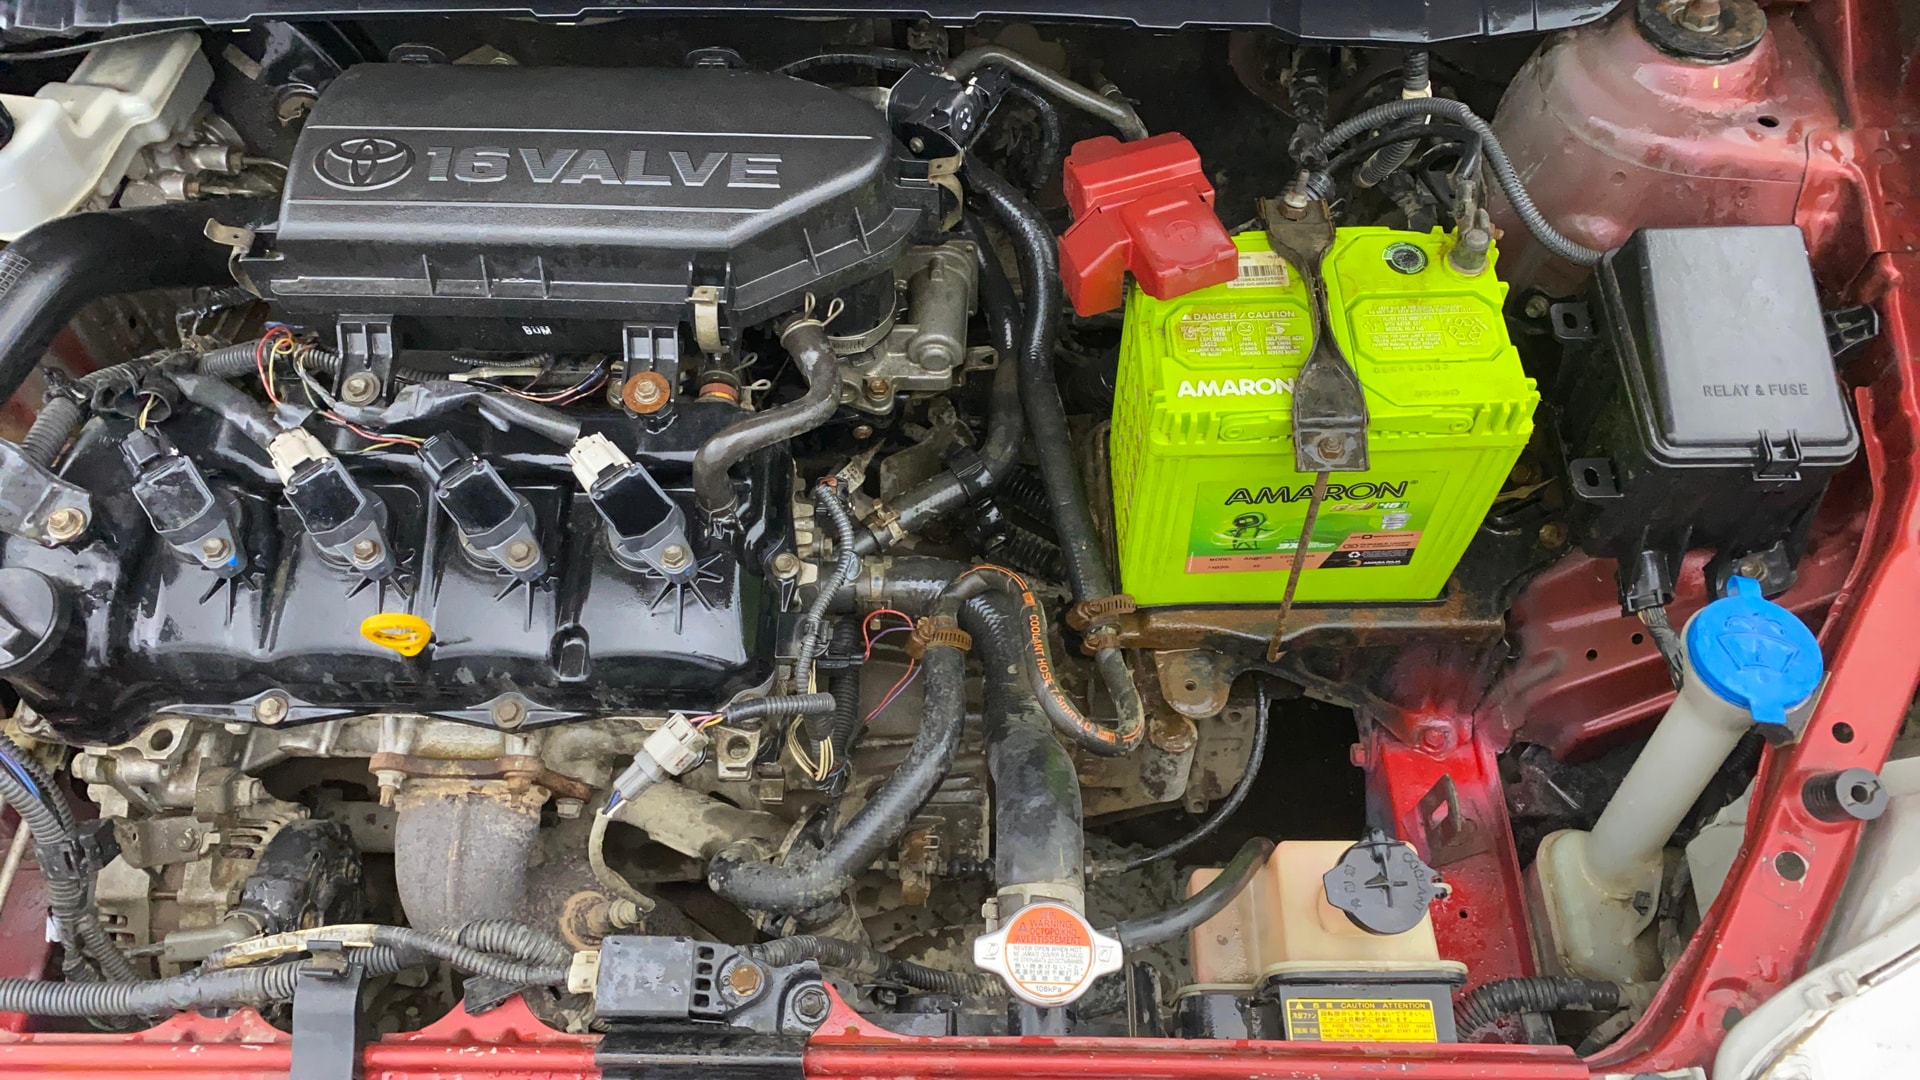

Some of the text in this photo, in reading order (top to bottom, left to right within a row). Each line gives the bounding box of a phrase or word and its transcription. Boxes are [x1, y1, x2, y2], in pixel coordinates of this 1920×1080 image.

[1193, 312, 1237, 321] DANGER
[1247, 311, 1295, 319] CAUTION
[1177, 378, 1295, 398] AMARON
[1702, 383, 1809, 397] RELAY & FUSE
[1225, 481, 1408, 506] AMARON
[1029, 614, 1045, 656] COOLANT
[1037, 658, 1055, 687] HOSE
[1050, 687, 1078, 722] 7.5mm
[1402, 852, 1427, 912] COOLANT
[1030, 919, 1072, 928] WARNING
[1030, 927, 1077, 936] ОСТОРОЖНО
[1016, 935, 1081, 944] AVERTISSEMENT
[1036, 985, 1062, 993] 108kPa
